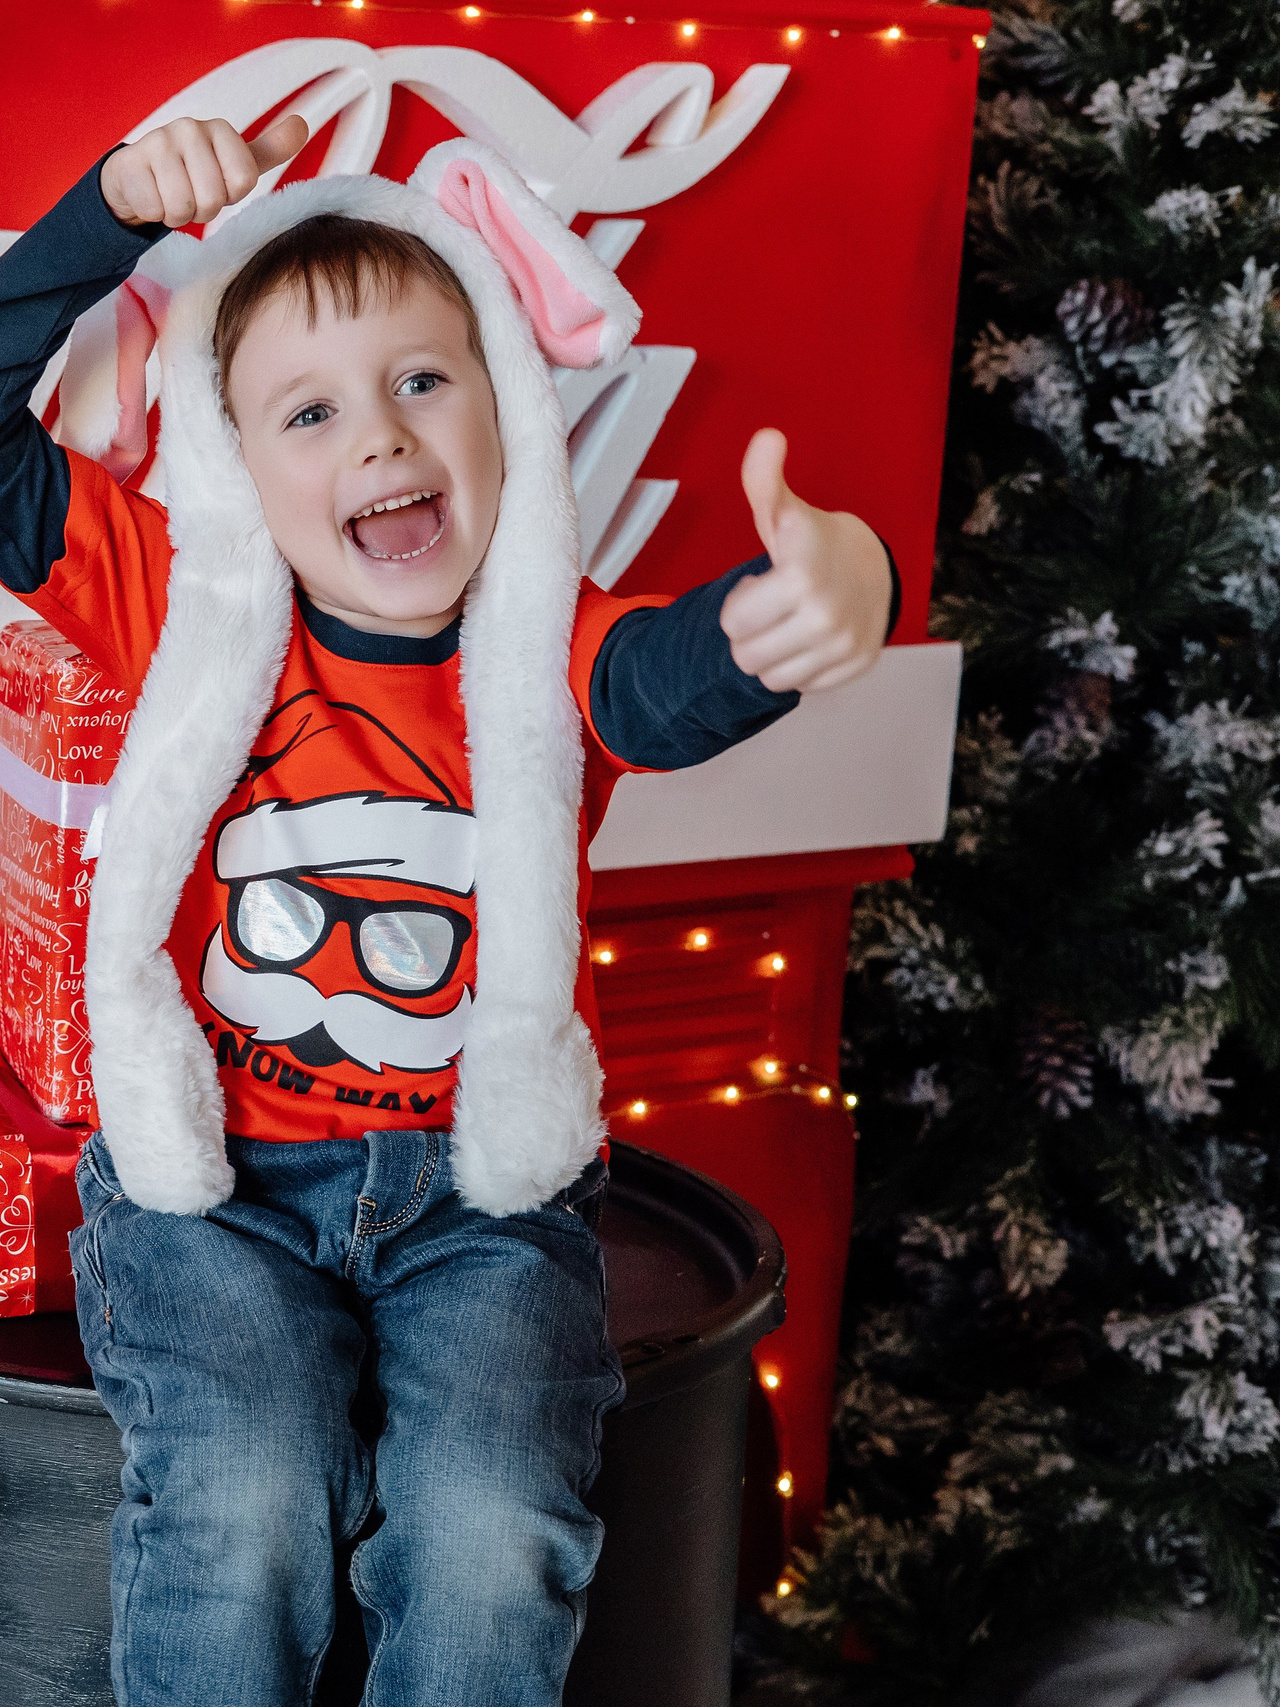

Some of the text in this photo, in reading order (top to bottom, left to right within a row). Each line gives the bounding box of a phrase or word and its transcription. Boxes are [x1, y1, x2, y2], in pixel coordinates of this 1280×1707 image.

[53, 671, 128, 706] Love
[66, 711, 131, 735] Joyeux
[56, 738, 103, 760] Love
[334, 1087, 438, 1114] WAY
